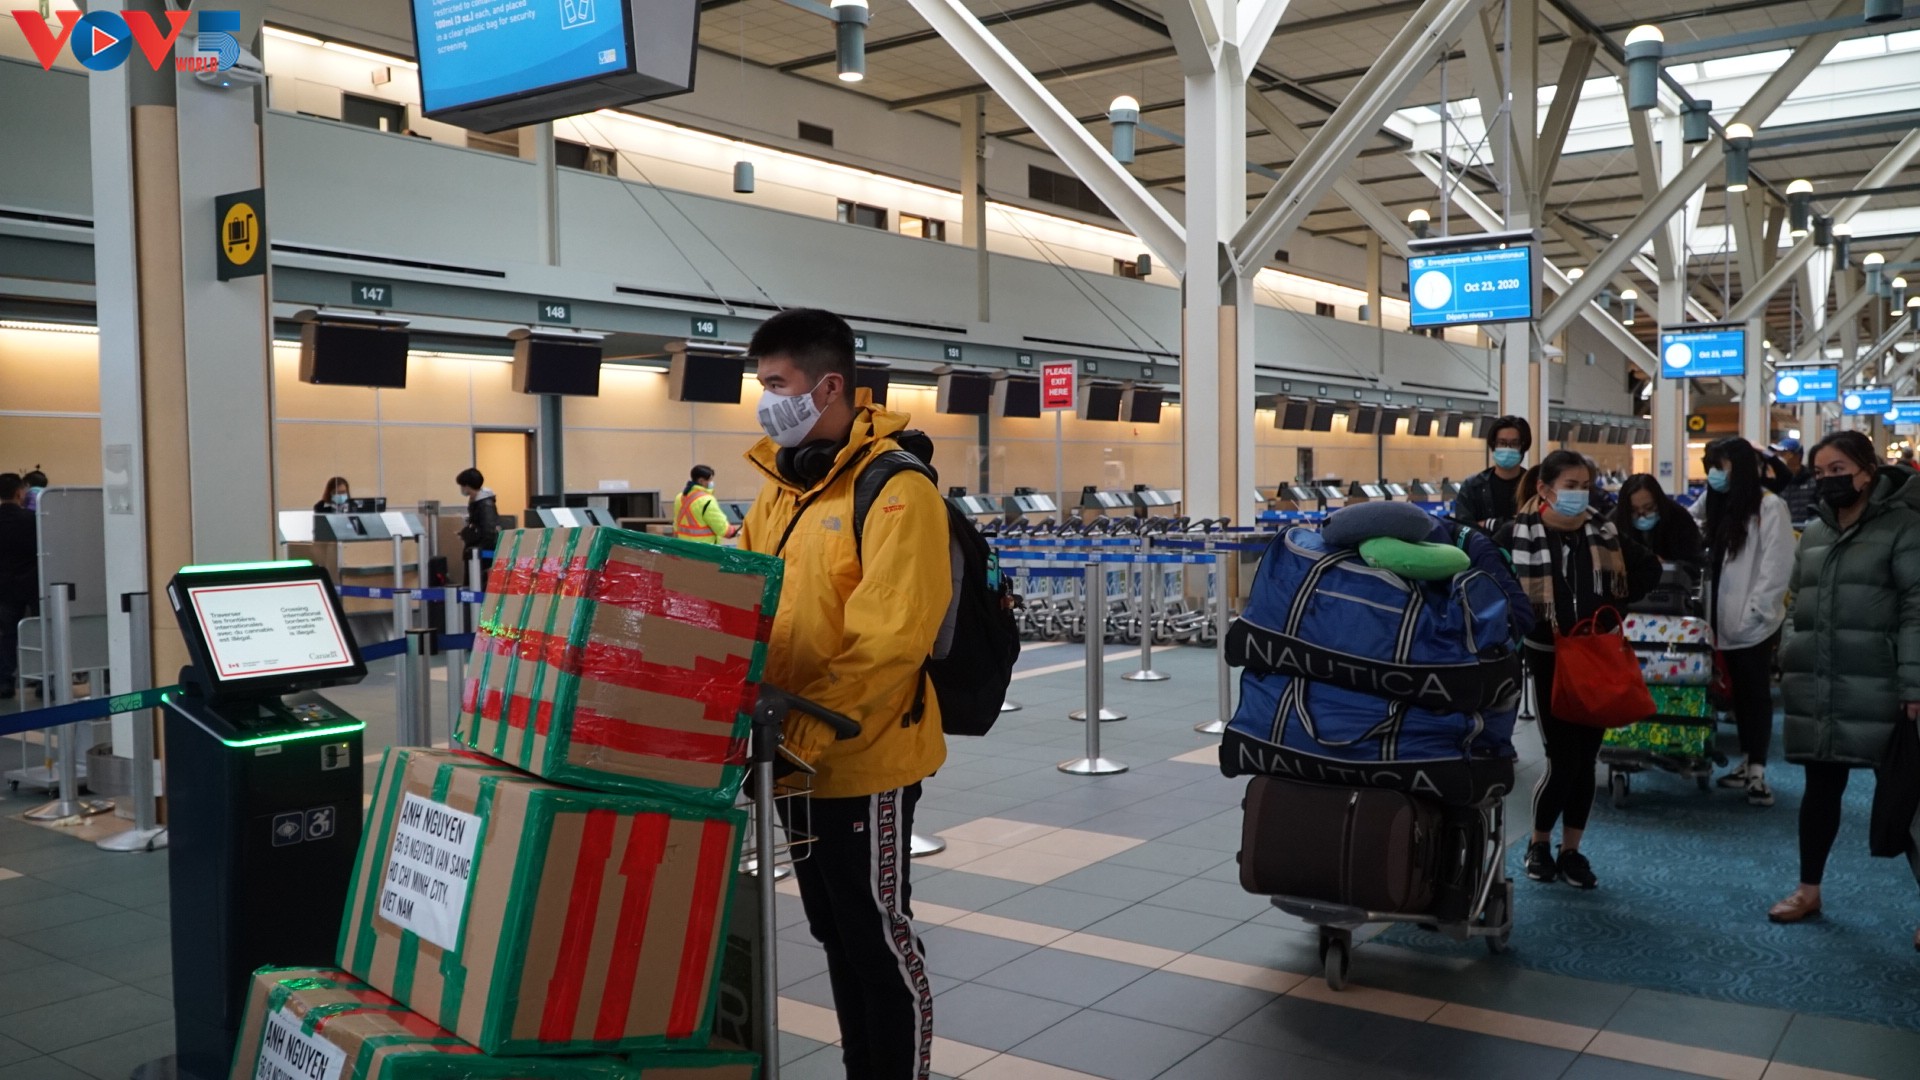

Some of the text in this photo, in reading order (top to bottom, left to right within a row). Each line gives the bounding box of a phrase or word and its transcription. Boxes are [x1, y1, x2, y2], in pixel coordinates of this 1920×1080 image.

[492, 5, 504, 15] and
[448, 29, 464, 39] clear
[464, 22, 486, 37] plastic
[485, 20, 498, 30] bag
[498, 16, 508, 25] for
[509, 10, 536, 23] security
[1428, 256, 1471, 267] Enregistrement
[1464, 279, 1520, 292] Oct 23, 2020
[360, 287, 384, 302] 147
[545, 306, 565, 319] 148
[697, 322, 713, 334] 149
[948, 348, 959, 358] 151
[1698, 350, 1711, 359] Oct
[1020, 355, 1031, 365] 152
[1045, 367, 1073, 376] PLEASE
[1051, 377, 1066, 386] EXIT
[1049, 388, 1069, 396] HERE
[280, 606, 309, 614] Crossing
[224, 616, 256, 624] frontières
[215, 622, 263, 630] internationales
[1245, 632, 1453, 702] NAUTICA
[401, 800, 466, 845] ANH NGUYEN
[394, 832, 471, 880] 56/9 NGUYEN VAN SANG
[388, 860, 449, 909] HO CHI MINH CITY,
[382, 889, 415, 921] VIET NAM
[265, 1021, 330, 1080] ANH NGUYEN
